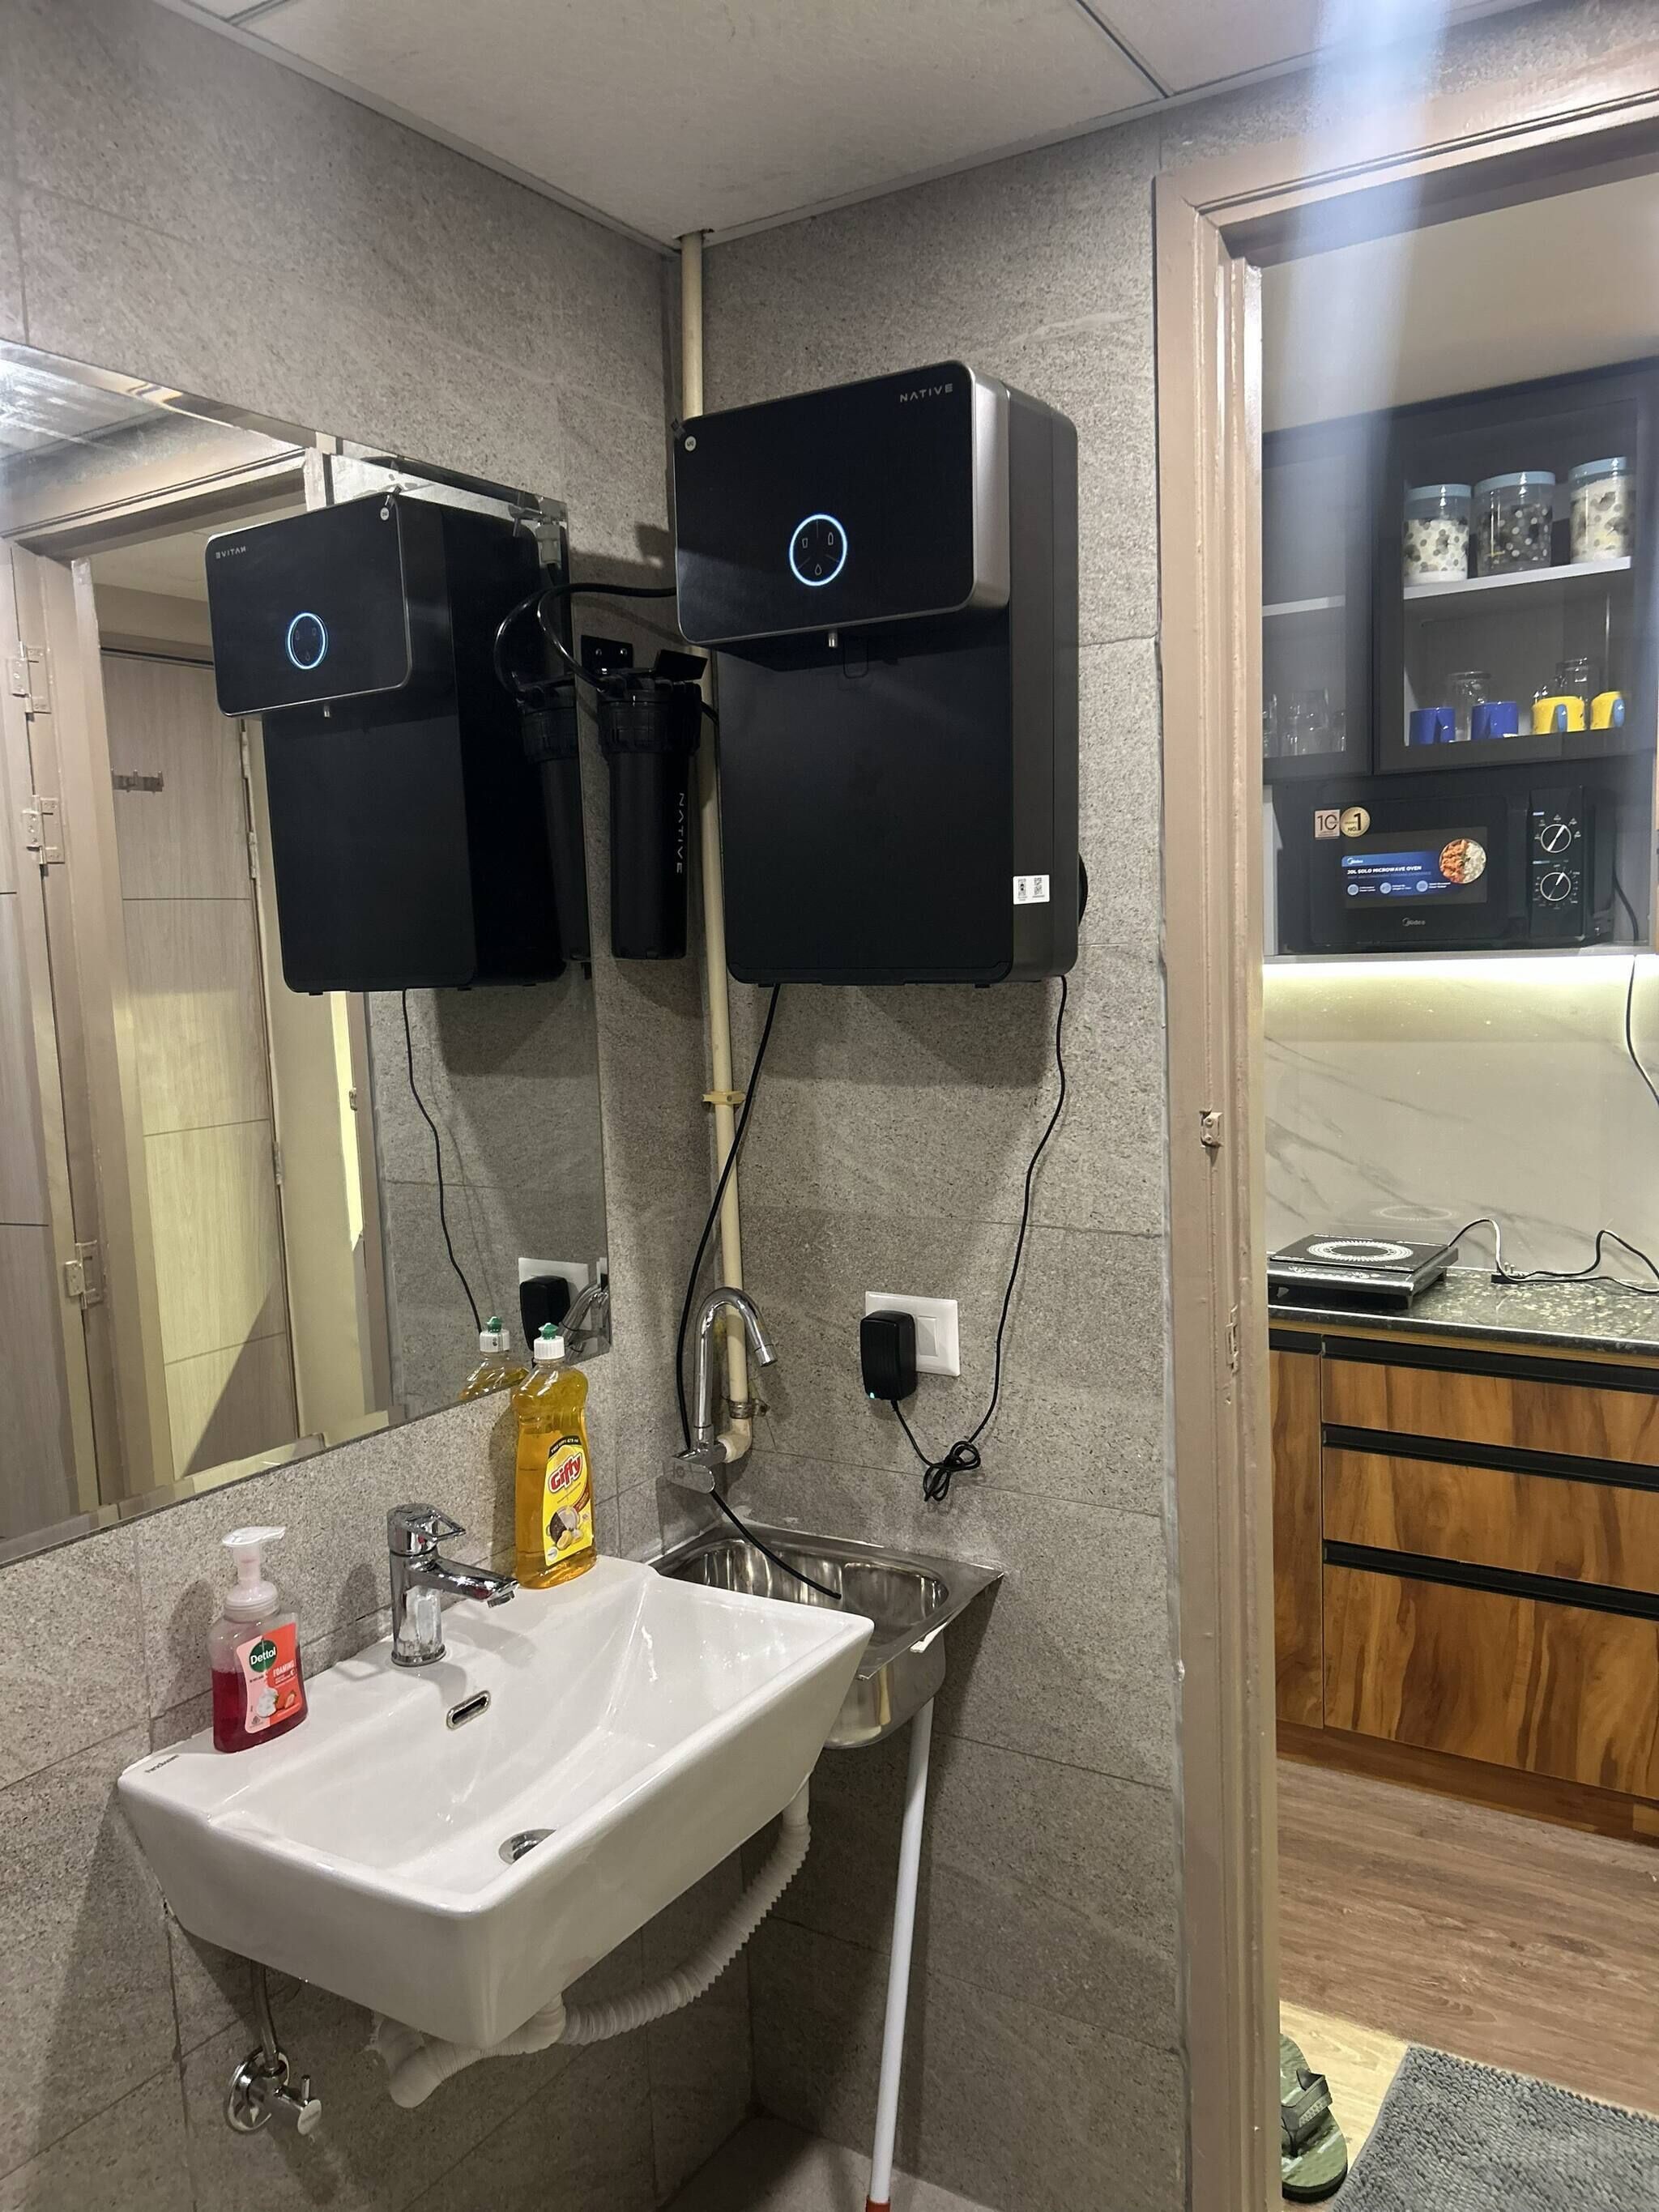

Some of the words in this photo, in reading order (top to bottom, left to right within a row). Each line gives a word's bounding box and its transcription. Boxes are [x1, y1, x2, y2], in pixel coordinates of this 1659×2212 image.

[899, 382, 953, 403] NATIVE
[676, 792, 685, 874] NATIVE
[550, 1454, 582, 1491] Giffy
[250, 1647, 276, 1665] Dettol
